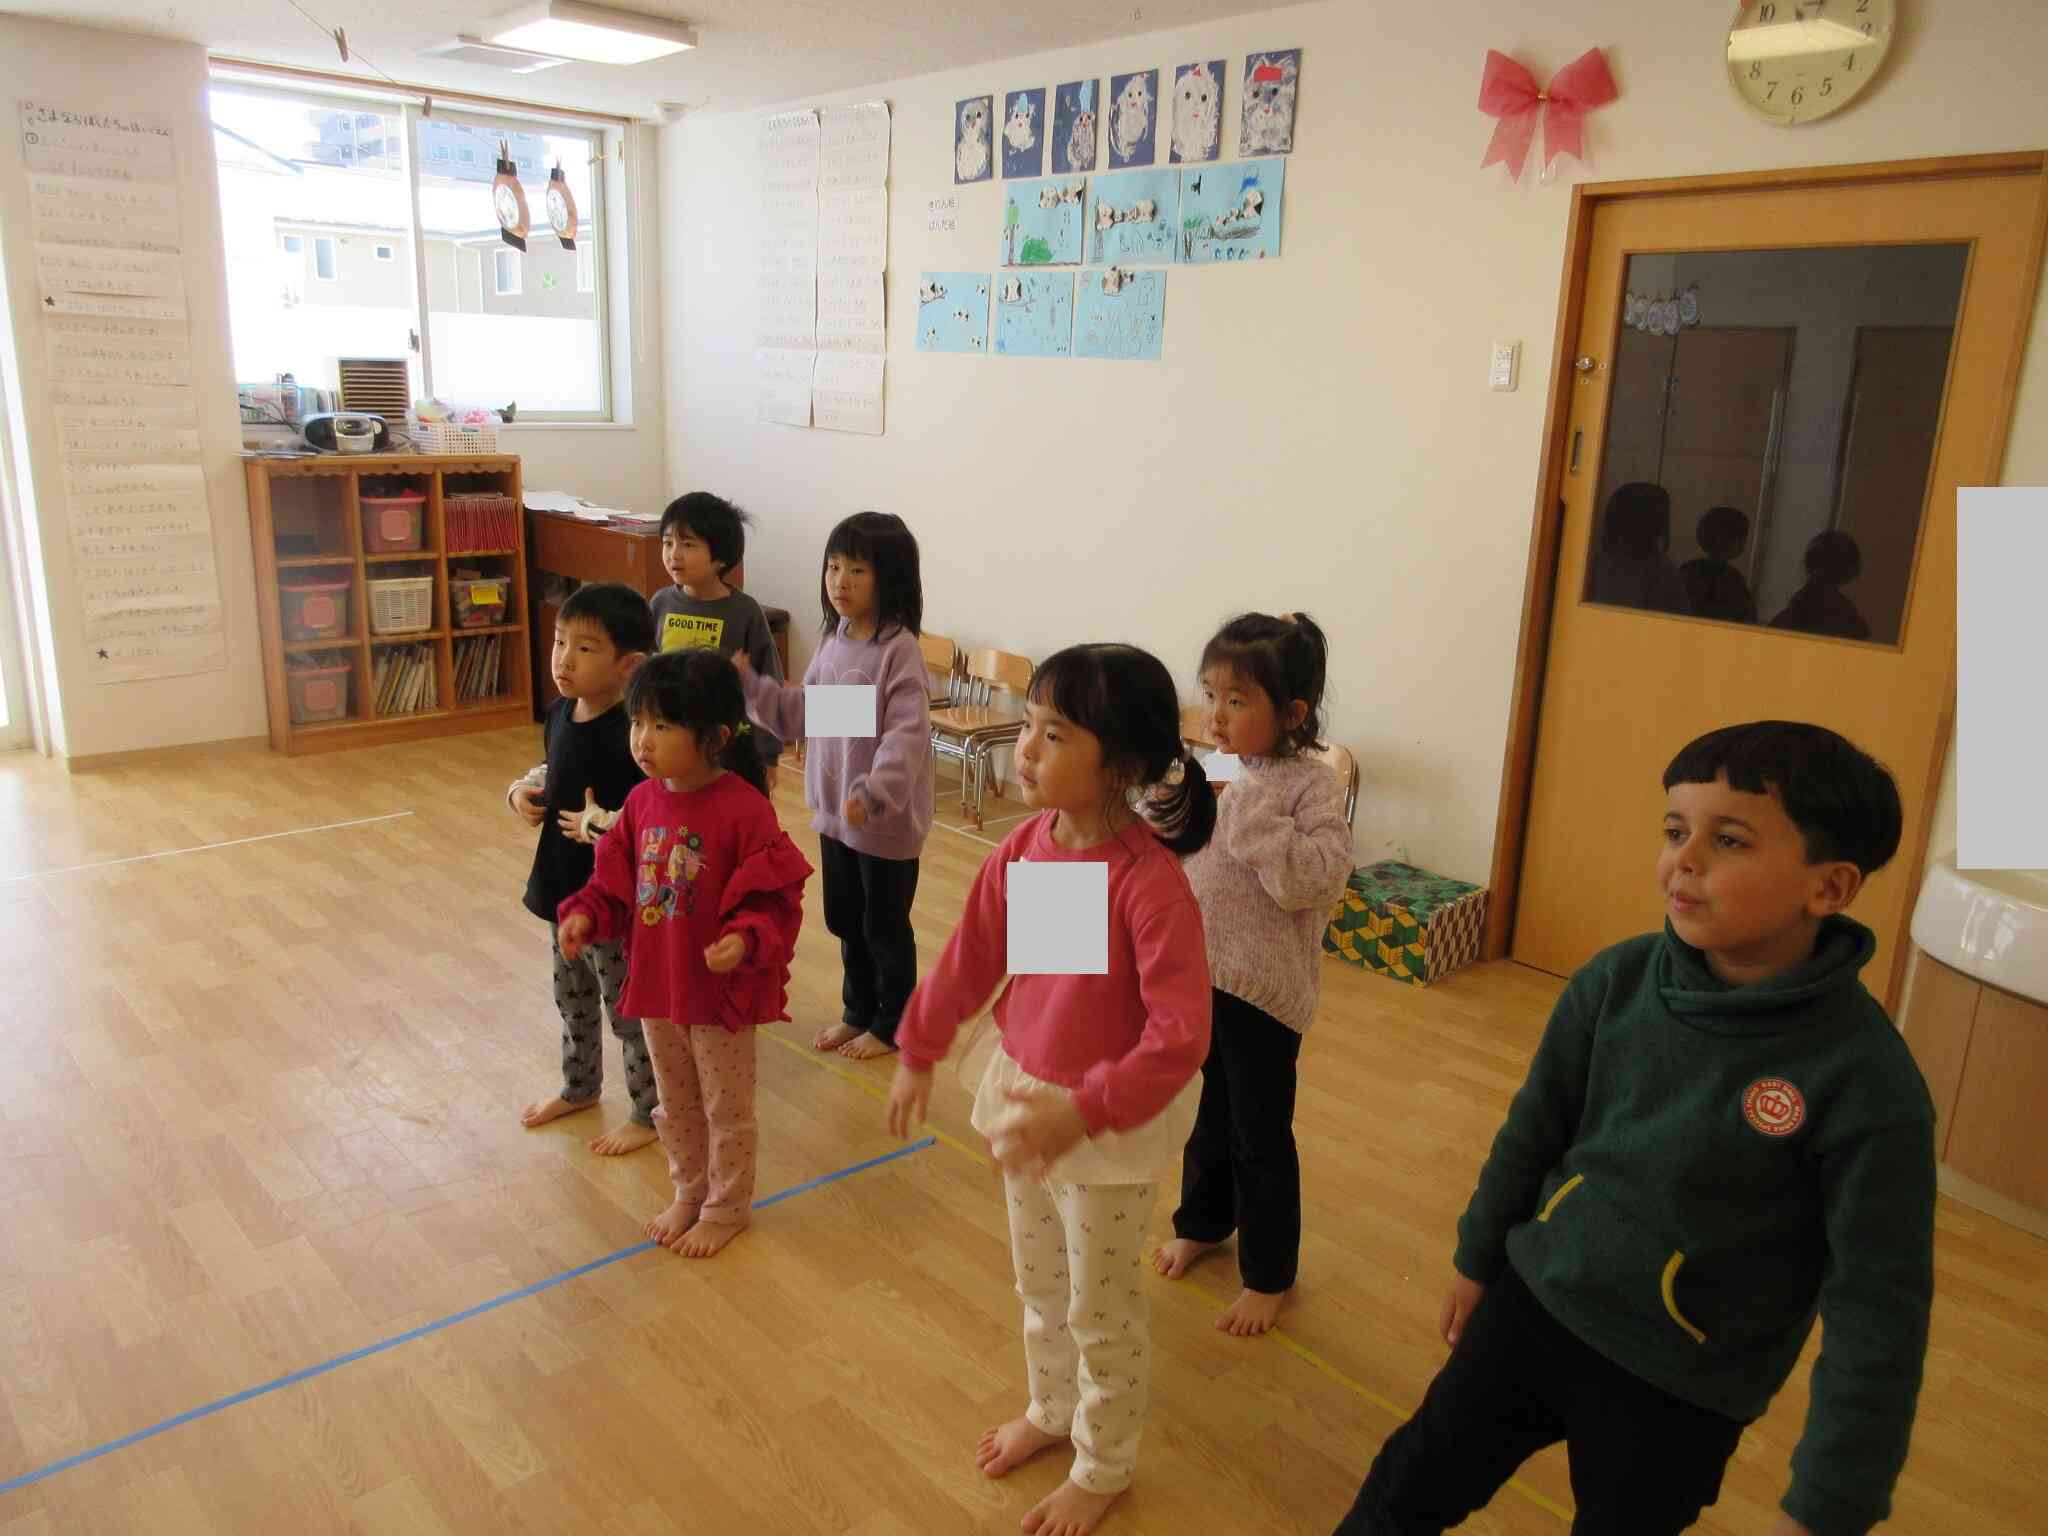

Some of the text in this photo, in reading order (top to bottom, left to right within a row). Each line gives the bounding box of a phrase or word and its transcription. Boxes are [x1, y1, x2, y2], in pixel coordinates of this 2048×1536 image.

[1759, 4, 1776, 23] 10
[1749, 61, 1761, 81] 8
[1840, 53, 1856, 71] 4
[1767, 81, 1780, 100] 7
[1791, 86, 1805, 105] 6
[1818, 77, 1833, 97] 5
[668, 617, 719, 633] GOOD TIME
